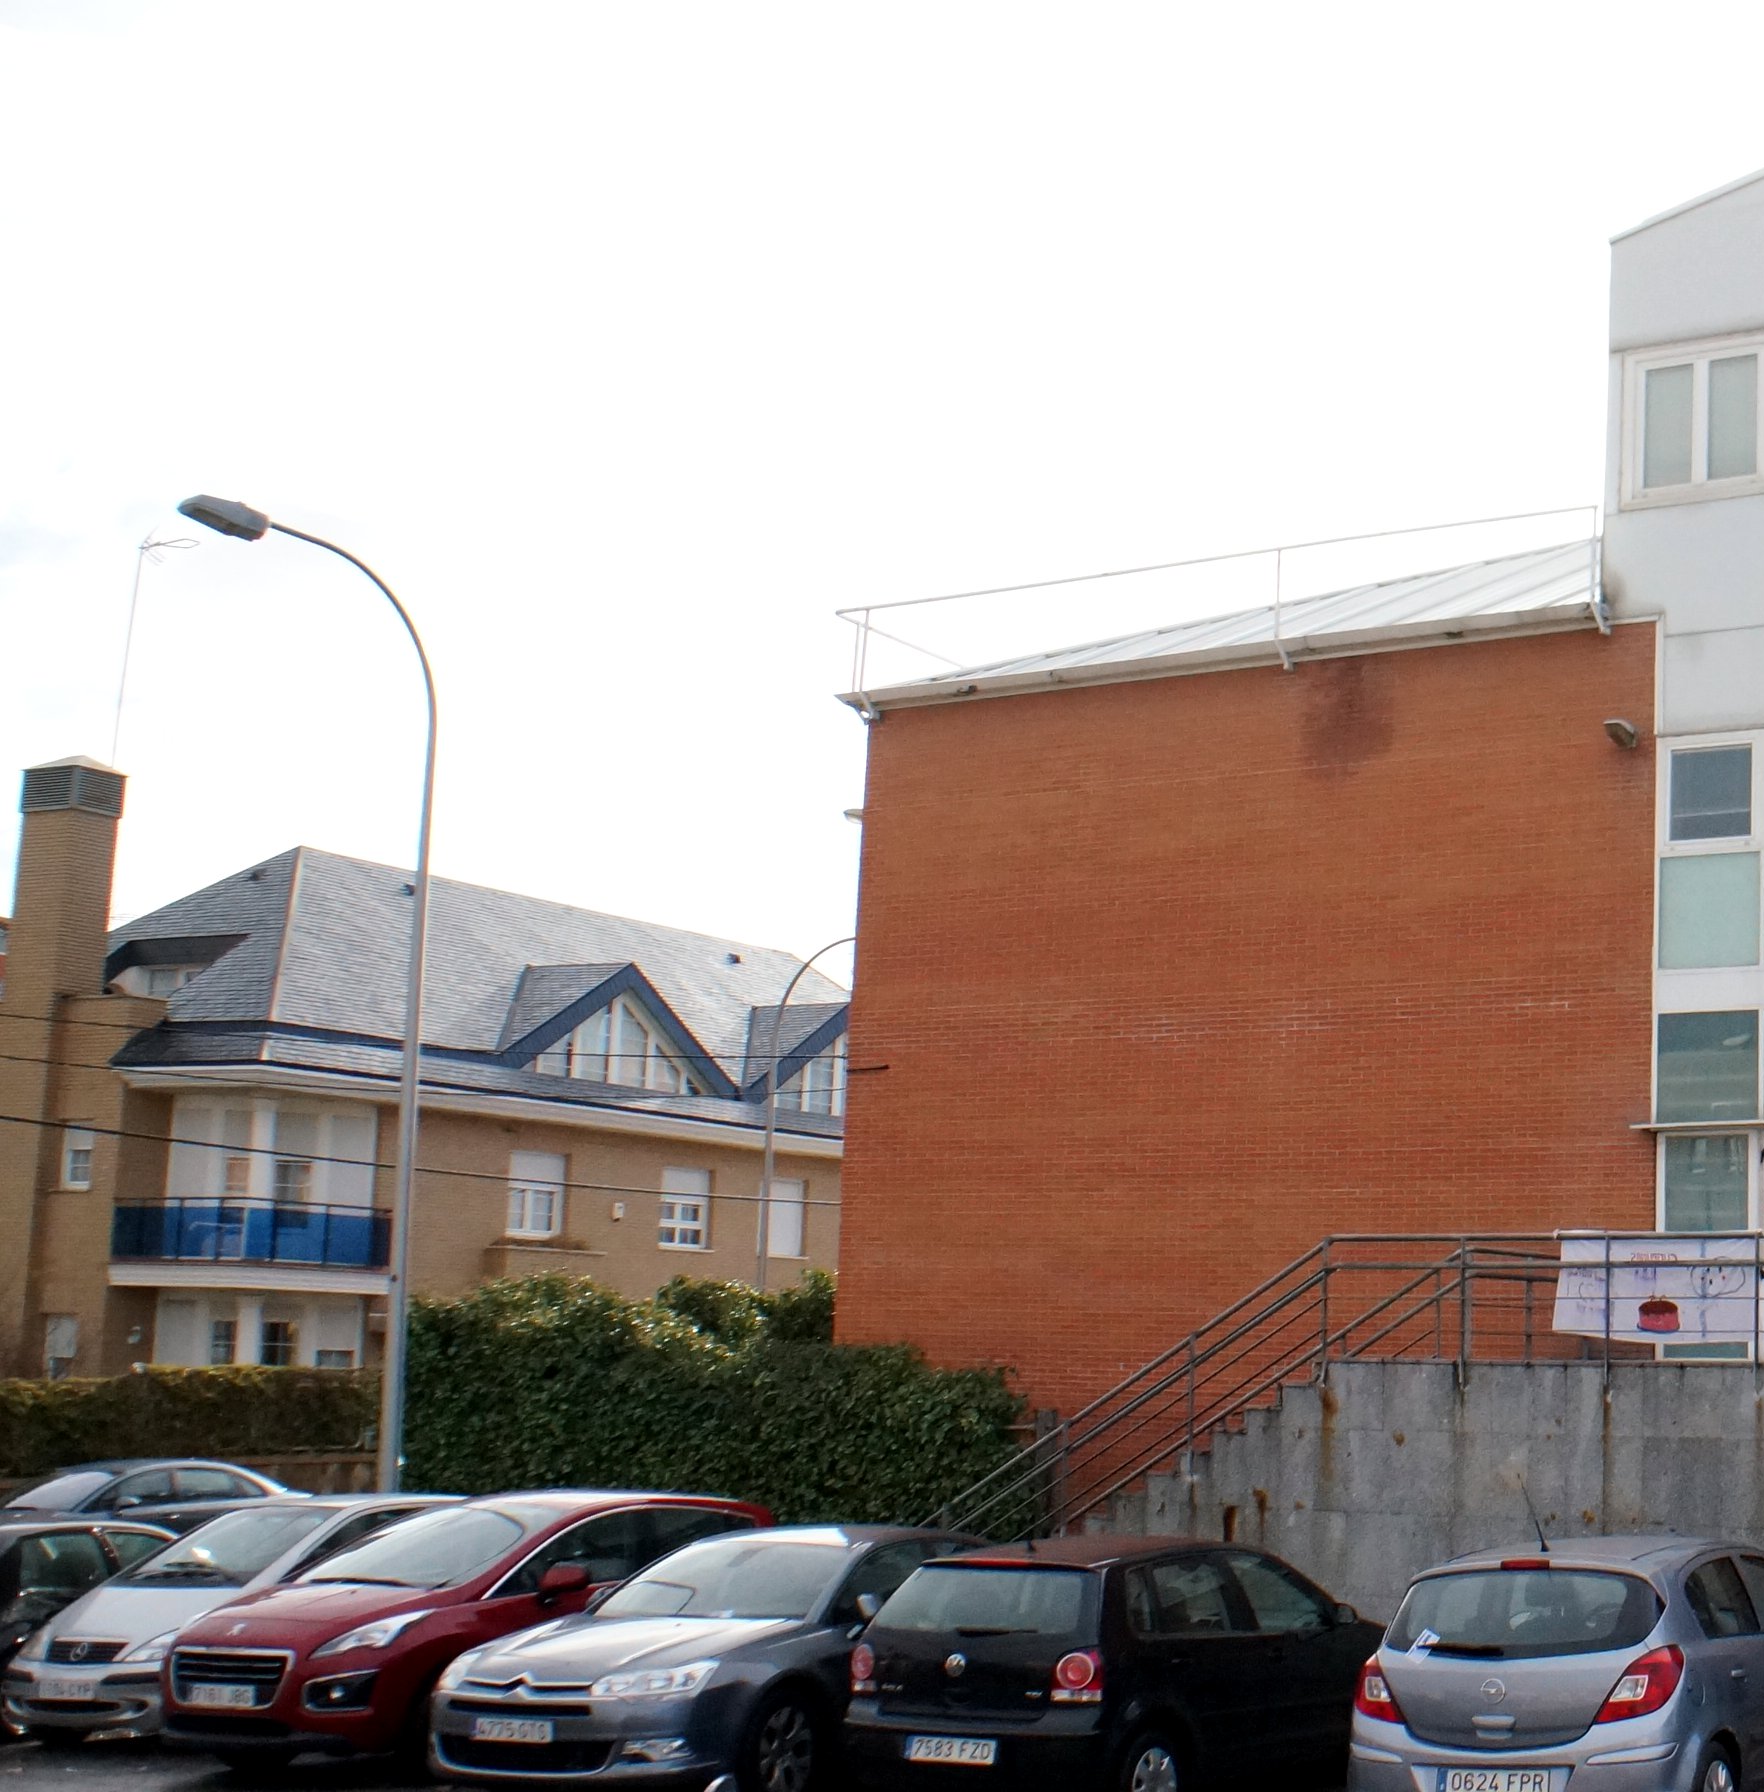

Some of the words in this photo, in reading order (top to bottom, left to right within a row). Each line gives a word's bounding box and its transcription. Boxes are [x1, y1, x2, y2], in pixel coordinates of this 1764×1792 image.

[914, 1738, 954, 1758] 7583
[1451, 1772, 1499, 1792] 0624
[1506, 1773, 1545, 1792] FPR
